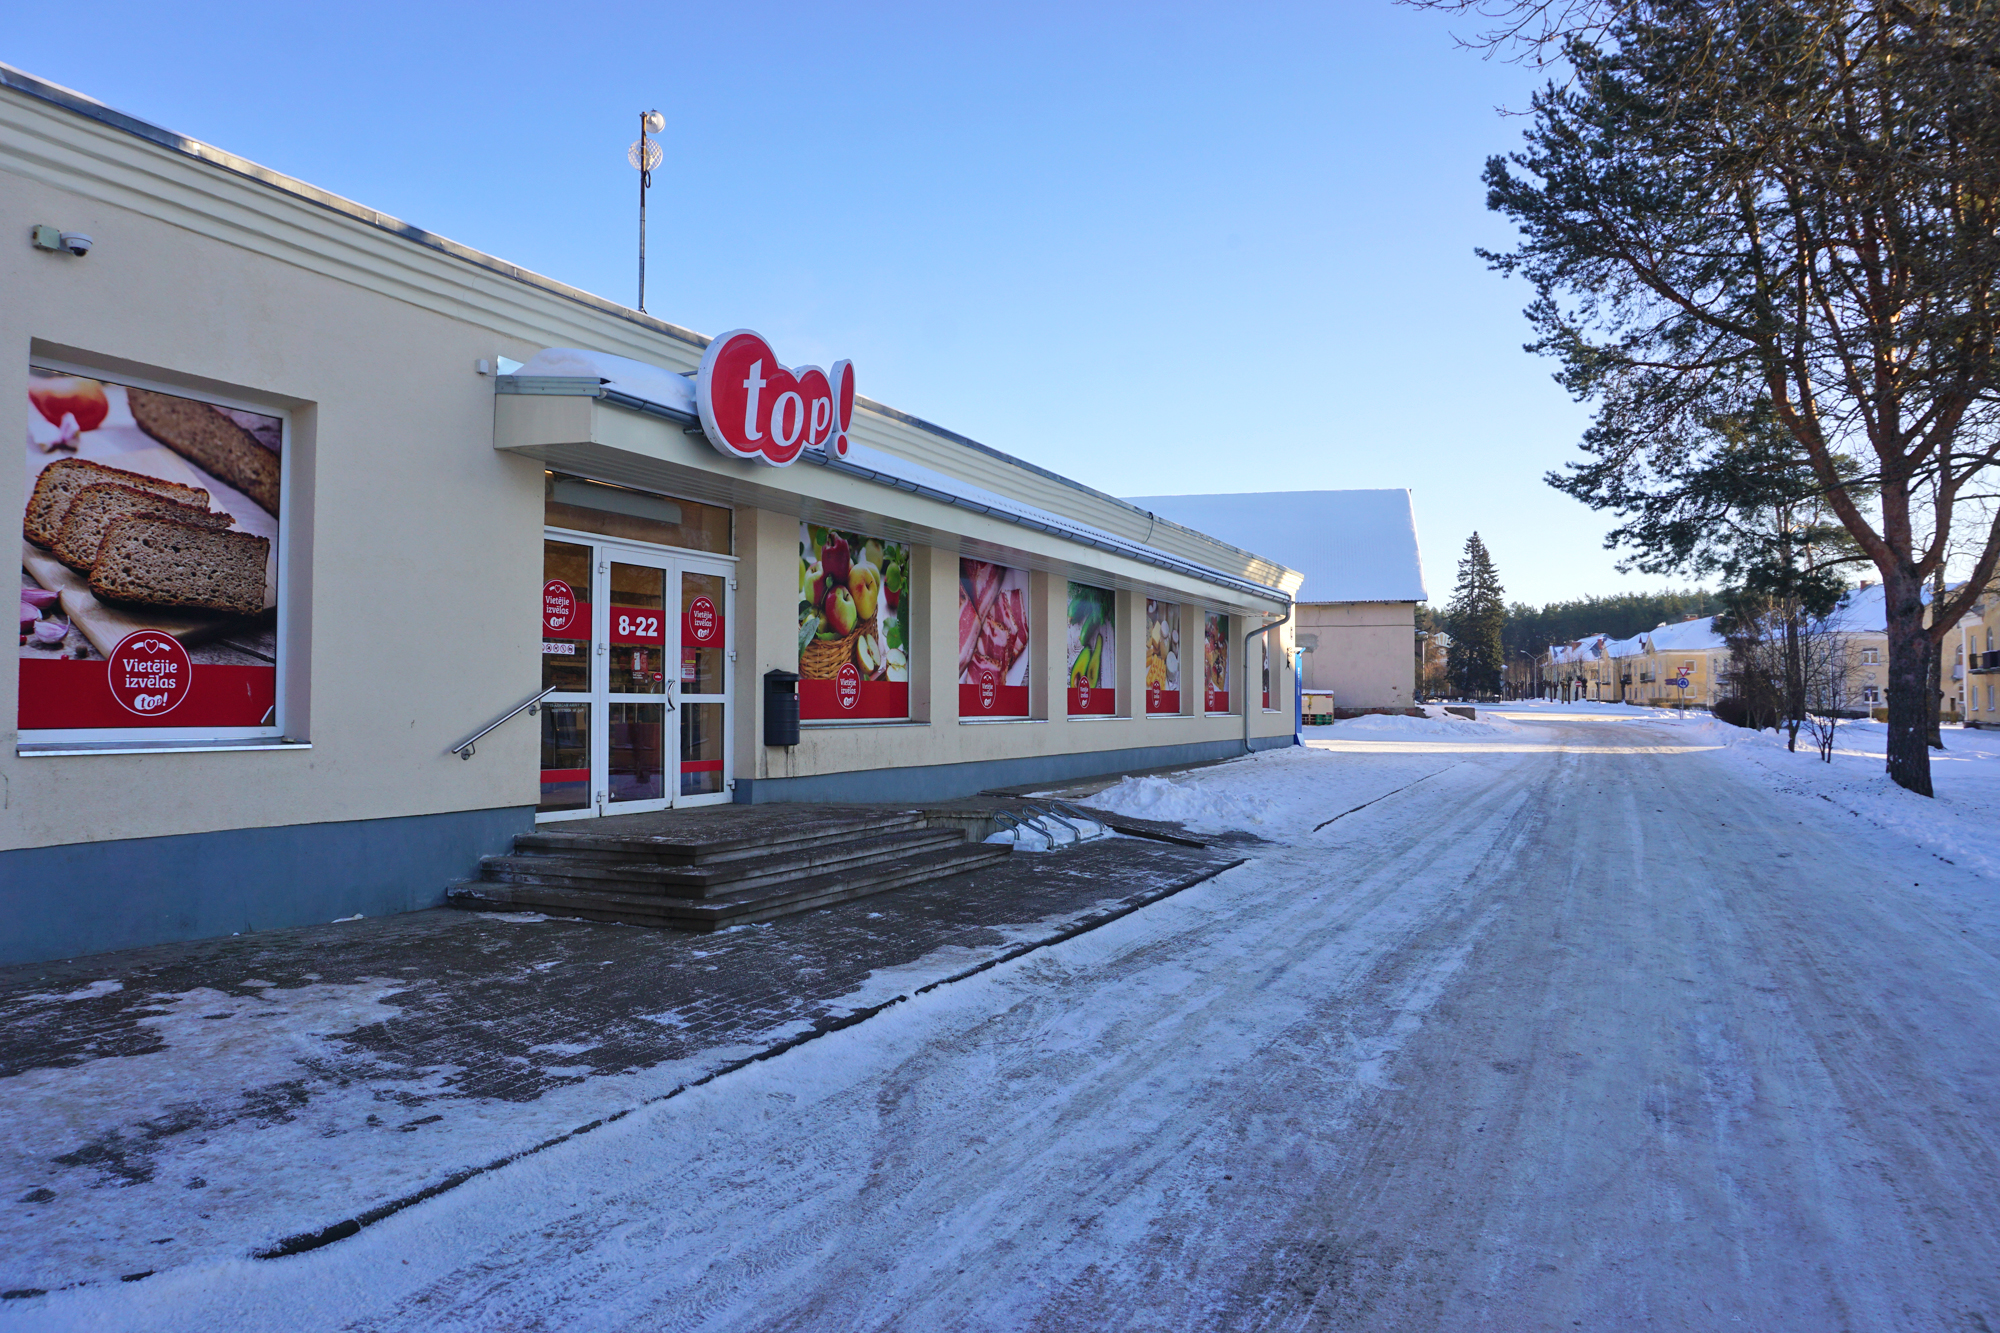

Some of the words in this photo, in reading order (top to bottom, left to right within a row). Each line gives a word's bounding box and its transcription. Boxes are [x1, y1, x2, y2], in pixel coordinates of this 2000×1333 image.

[743, 358, 854, 456] top!
[545, 596, 569, 607] Vietējie
[546, 605, 569, 615] izvēlas
[619, 615, 658, 637] 8-22
[123, 658, 178, 677] Vietējie
[125, 674, 176, 689] izvēlas
[135, 692, 169, 710] top!
